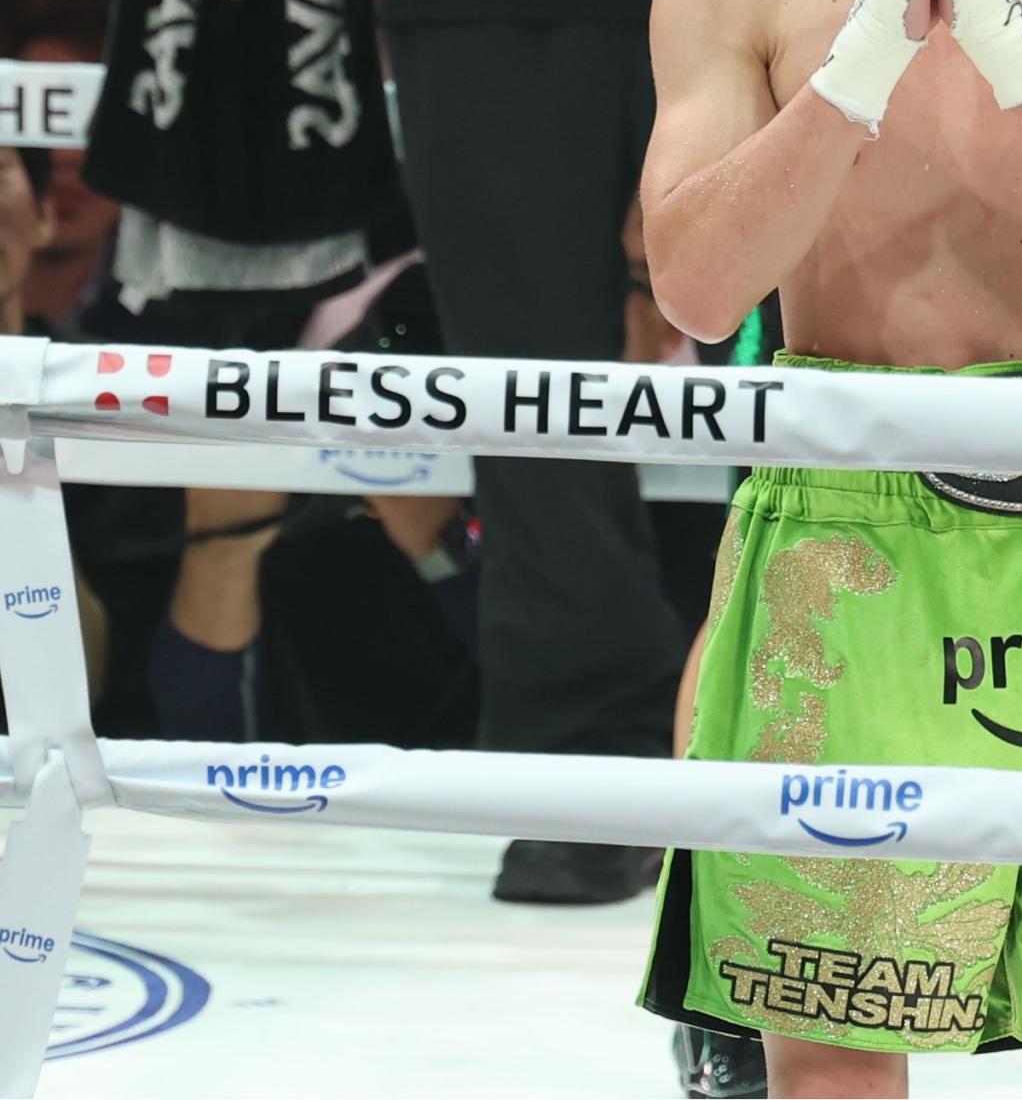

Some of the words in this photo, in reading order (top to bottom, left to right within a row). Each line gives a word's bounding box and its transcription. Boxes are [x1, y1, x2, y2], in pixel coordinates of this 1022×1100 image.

[205, 360, 467, 431] BLESS
[504, 370, 784, 443] HEART
[4, 585, 61, 611] prime
[780, 769, 923, 816] prime
[0, 927, 55, 953] prime
[767, 939, 954, 998] TEAM
